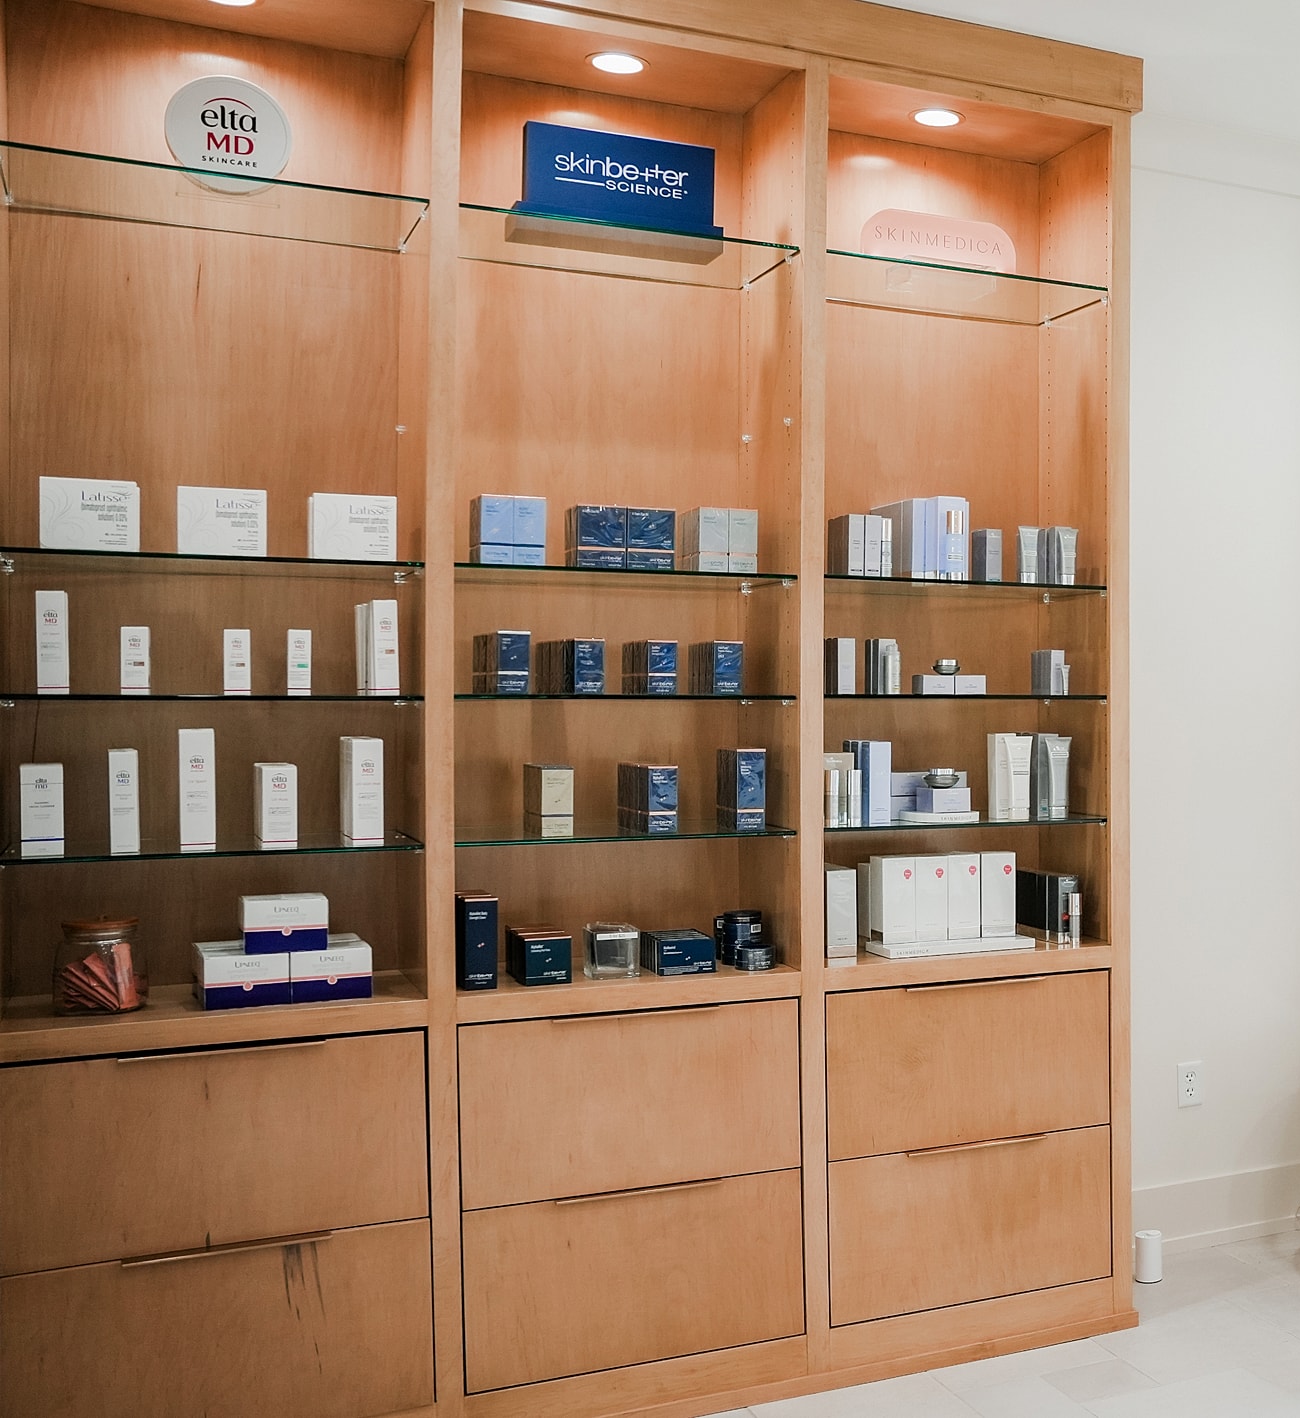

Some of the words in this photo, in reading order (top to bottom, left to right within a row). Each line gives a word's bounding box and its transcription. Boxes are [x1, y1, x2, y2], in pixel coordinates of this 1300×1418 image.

[200, 105, 258, 133] elta
[207, 131, 254, 155] MD
[201, 155, 258, 168] SKINCARE
[554, 151, 689, 187] skinbetter
[605, 180, 684, 200] SCIENCE
[874, 225, 1002, 255] SKINMEDICA
[271, 775, 288, 783] elta
